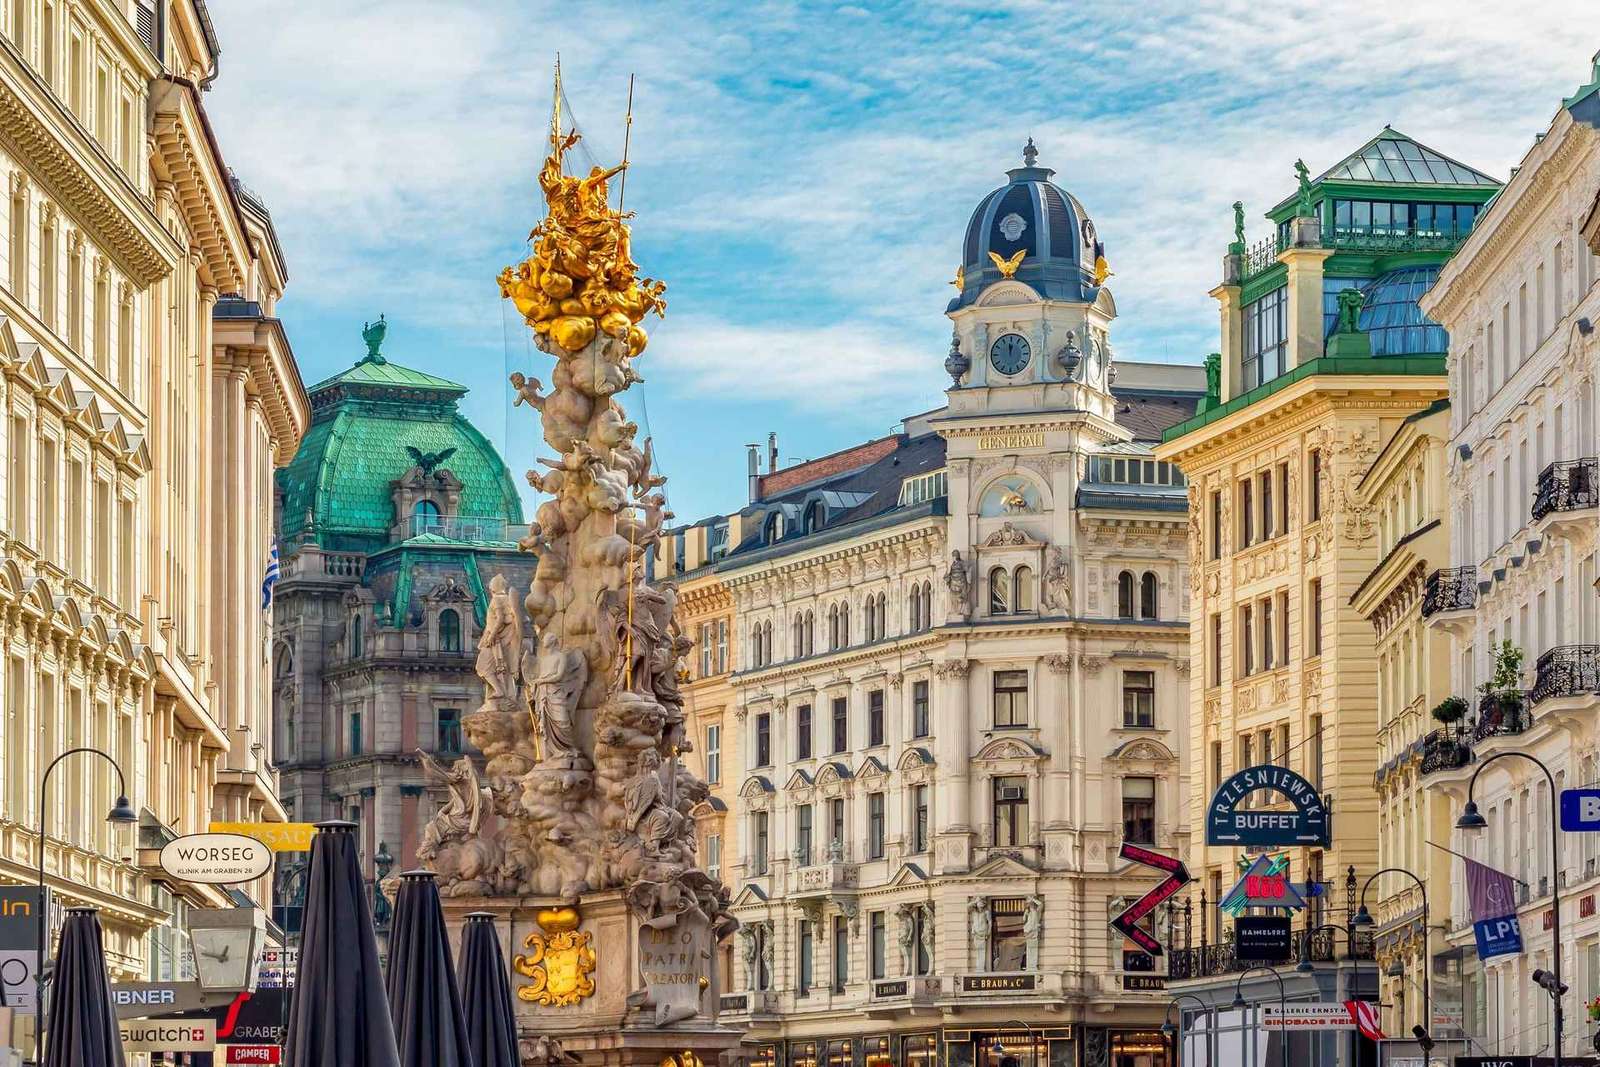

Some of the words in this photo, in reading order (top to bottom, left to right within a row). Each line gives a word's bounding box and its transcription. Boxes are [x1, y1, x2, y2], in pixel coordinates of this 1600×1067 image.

[977, 433, 1045, 450] GENERALI
[1235, 815, 1299, 829] BUFFET
[177, 847, 254, 861] WORSEG
[981, 979, 1008, 988] BRAUN
[120, 1027, 190, 1042] swatch
[235, 1048, 269, 1061] CAMPER
